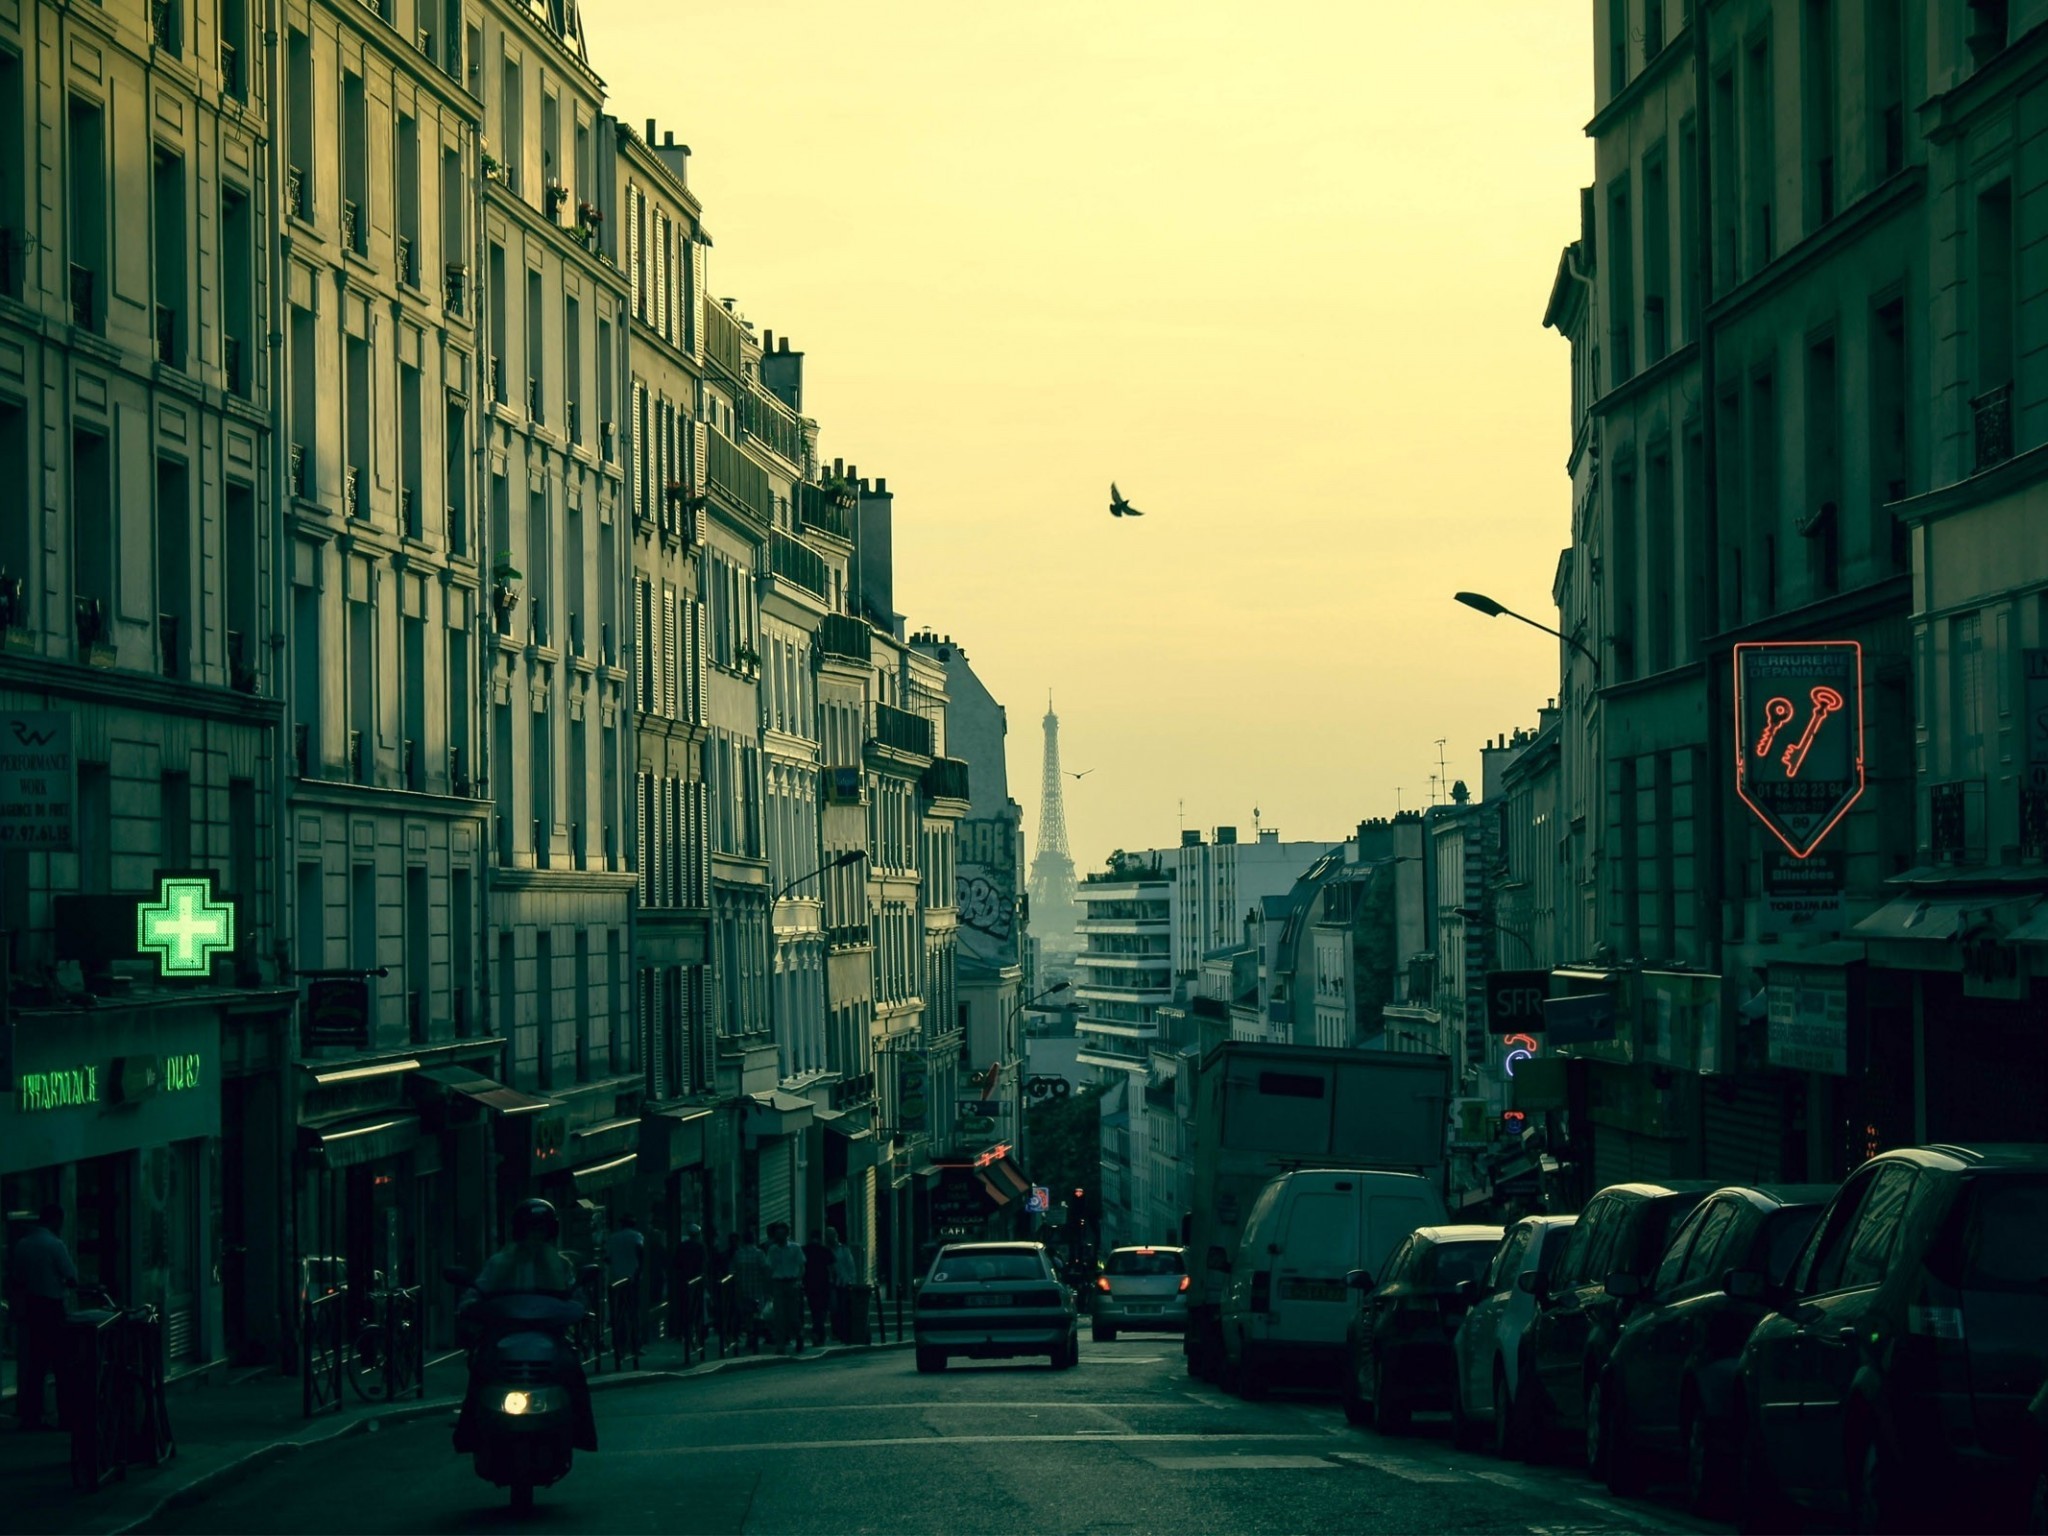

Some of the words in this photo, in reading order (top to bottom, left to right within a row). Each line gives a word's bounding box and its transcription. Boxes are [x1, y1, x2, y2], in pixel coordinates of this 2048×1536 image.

[1747, 654, 1848, 667] SERRURERIE
[1749, 666, 1846, 678] DEPANNAGE
[20, 778, 47, 795] WORK
[1756, 783, 1771, 798] 01
[1774, 783, 1790, 798] 42
[1793, 783, 1808, 798] 02
[1810, 782, 1826, 798] 23
[1497, 988, 1543, 1017] SFR
